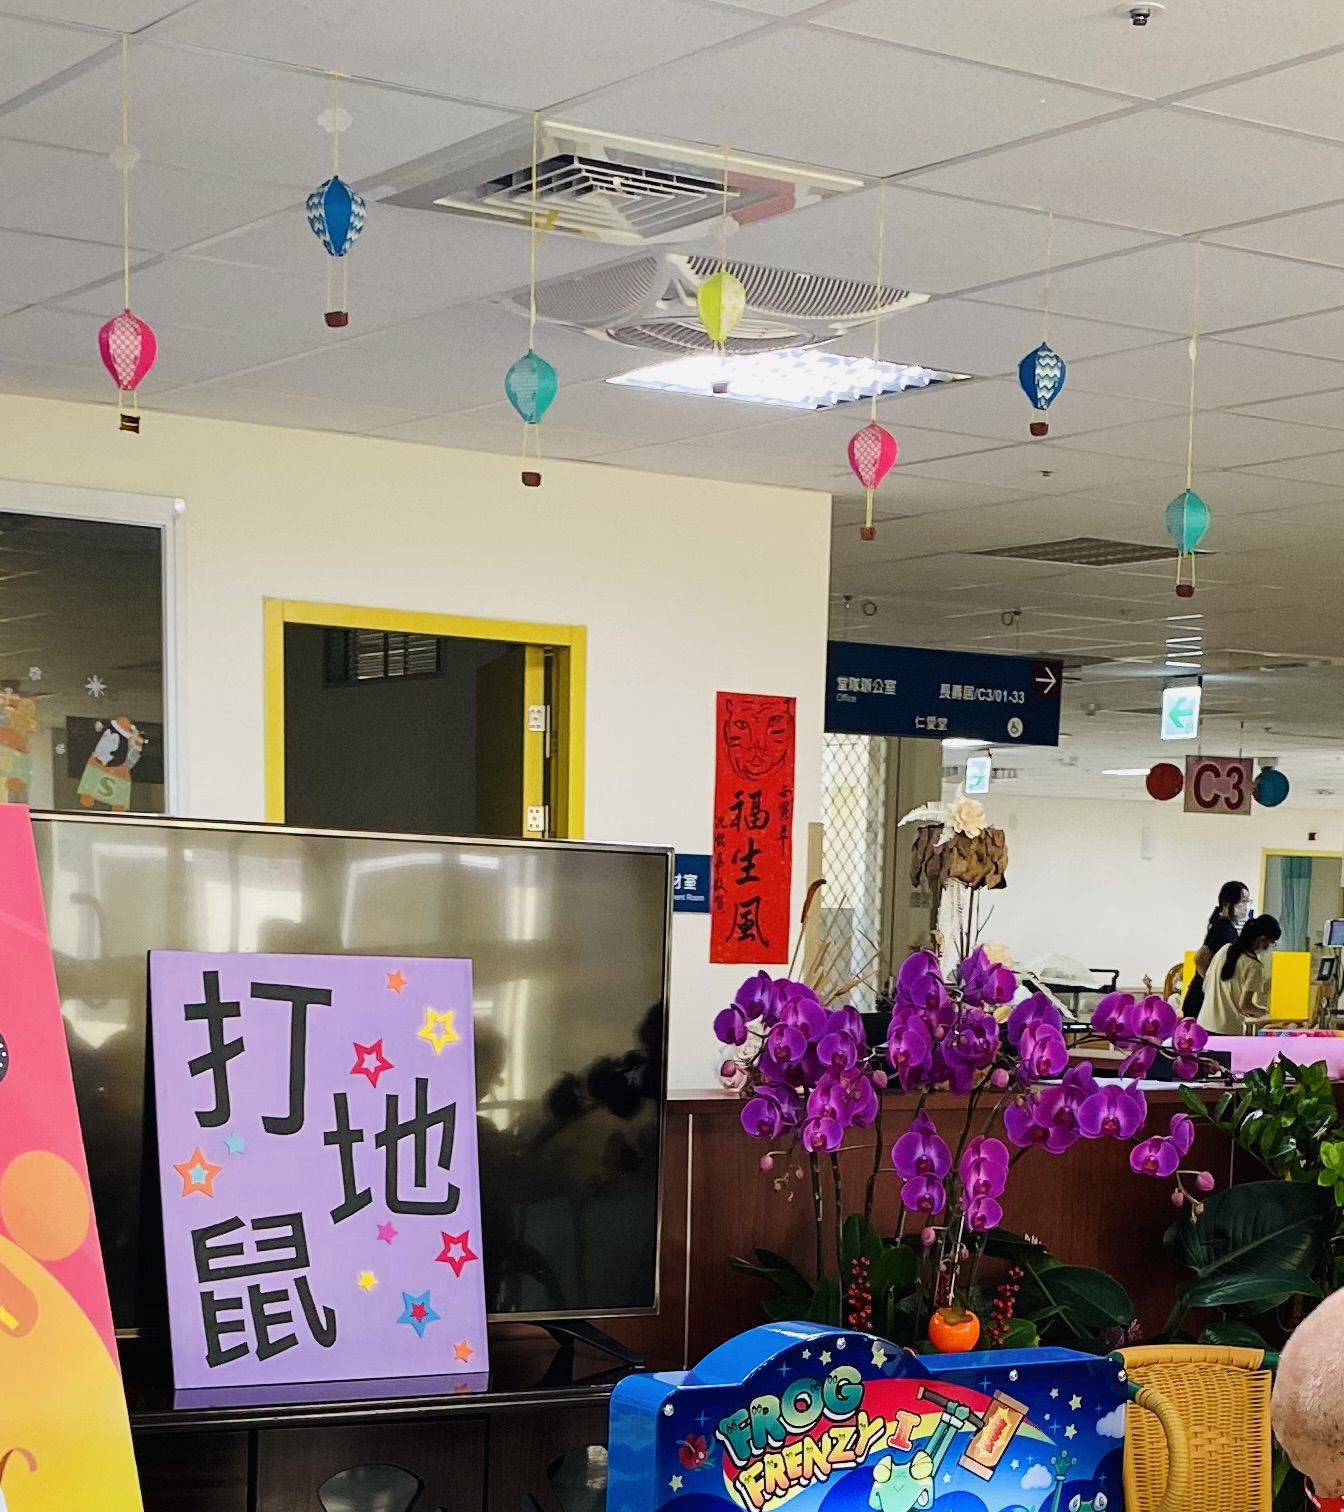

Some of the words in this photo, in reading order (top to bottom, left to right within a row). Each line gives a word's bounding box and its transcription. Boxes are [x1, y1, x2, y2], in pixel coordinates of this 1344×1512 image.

[1194, 764, 1244, 810] C3
[726, 789, 770, 948] 福生風
[183, 970, 461, 1368] 打地鼠
[716, 1365, 864, 1467] FROG
